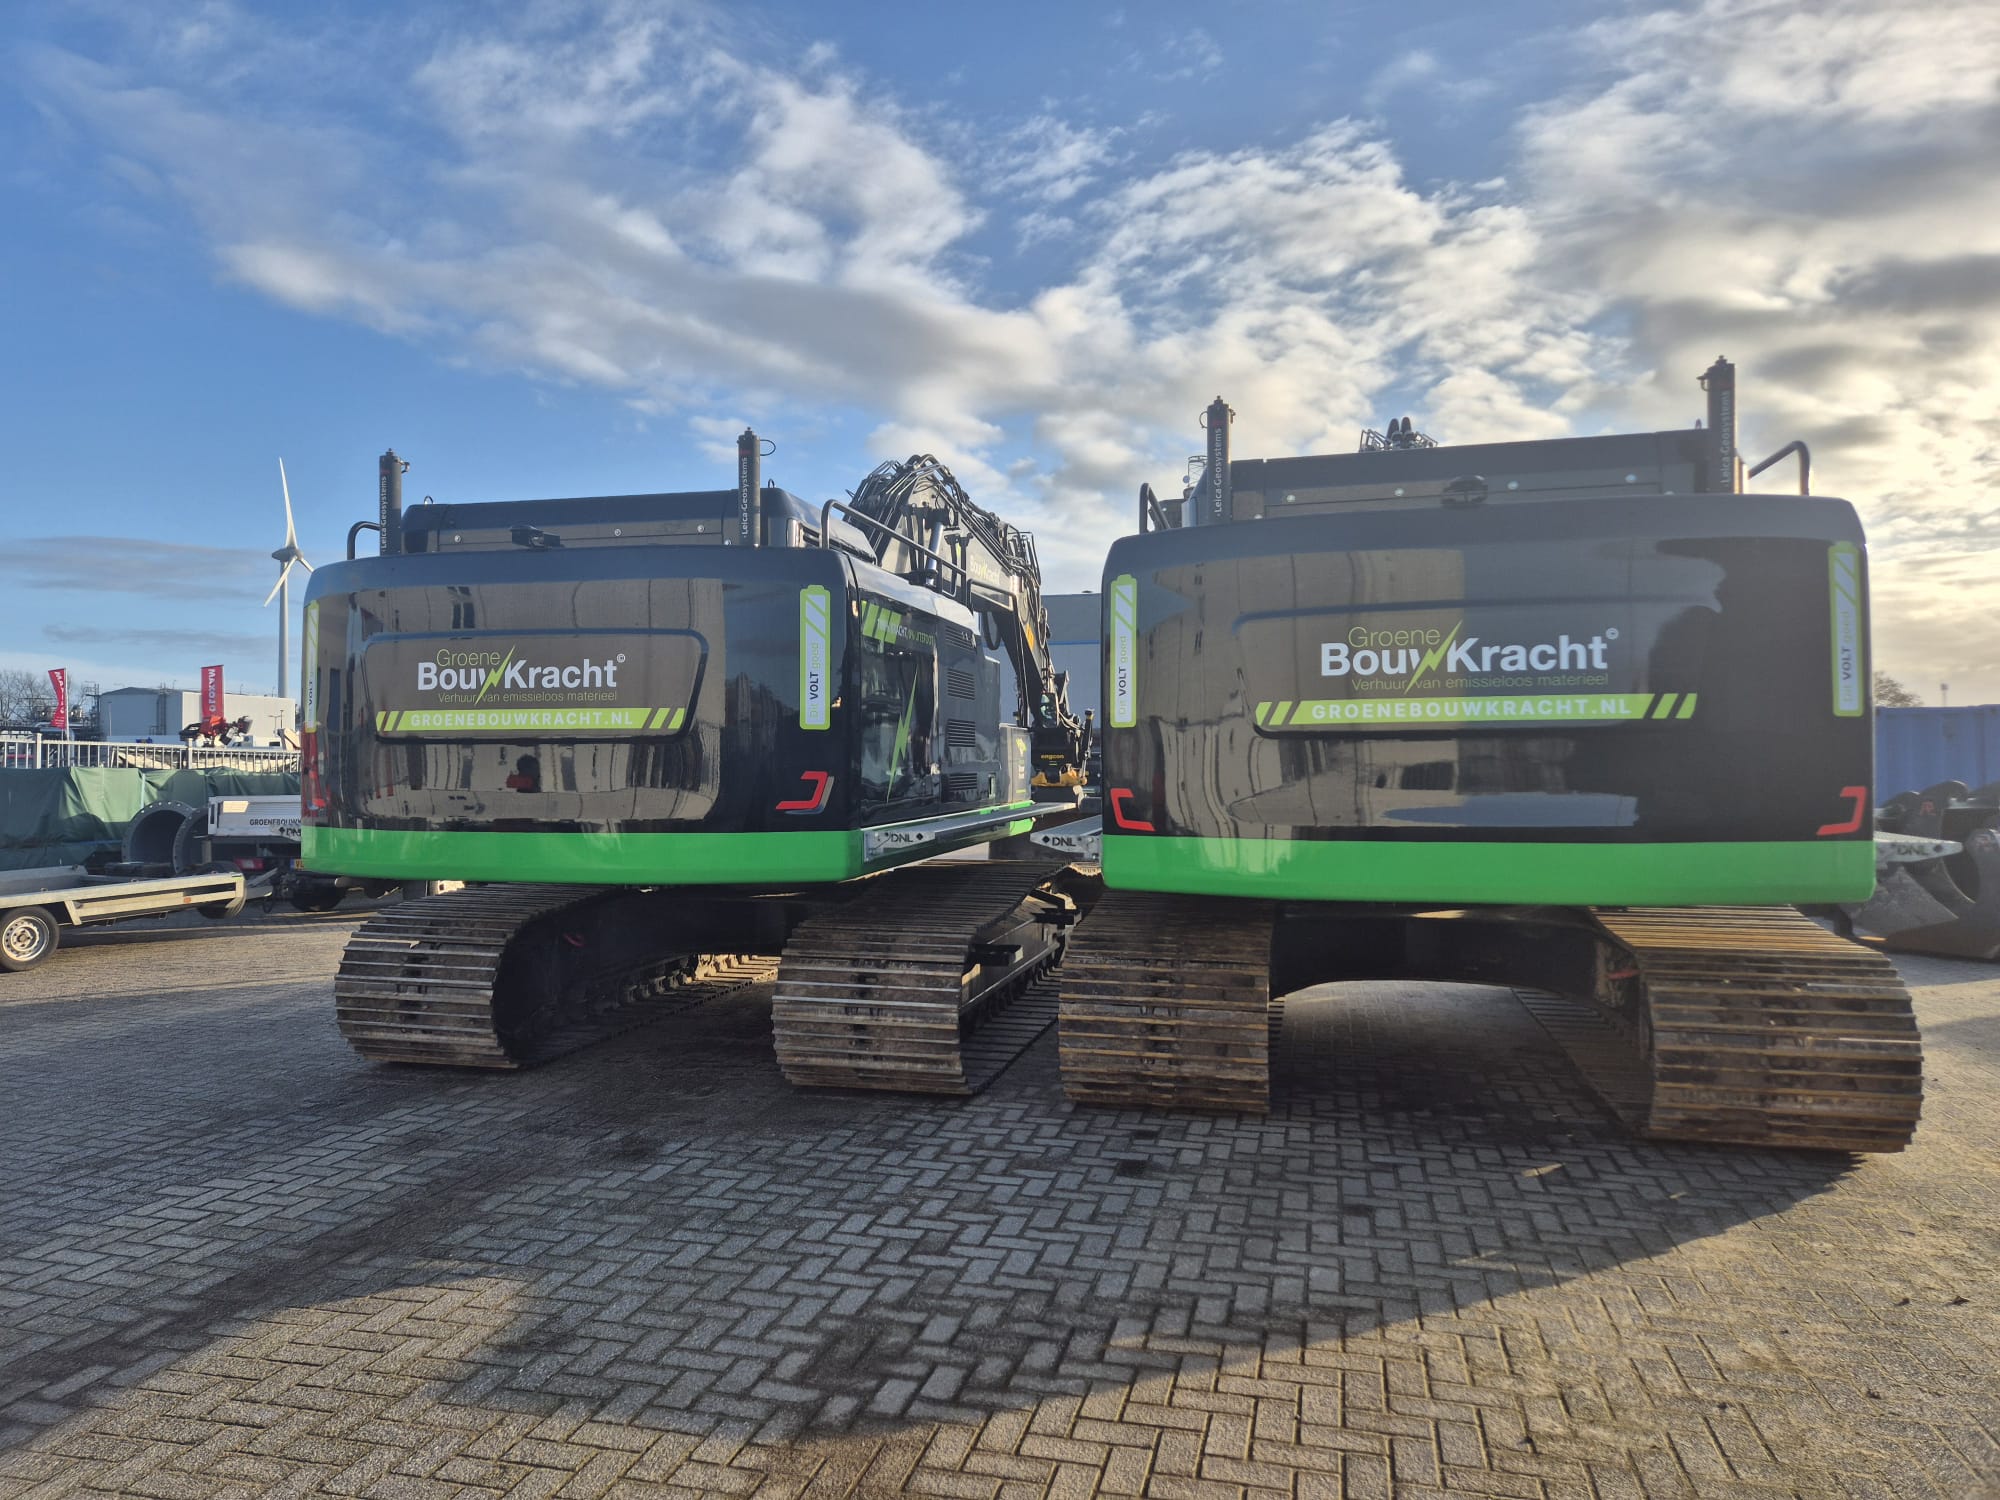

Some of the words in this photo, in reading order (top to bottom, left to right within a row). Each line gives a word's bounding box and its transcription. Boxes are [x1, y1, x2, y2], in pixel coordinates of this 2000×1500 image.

[1214, 427, 1222, 486] Geosystems
[741, 457, 749, 511] Geosystems
[1214, 488, 1222, 513] Leica
[1348, 626, 1441, 647] Groene
[436, 649, 500, 667] Groene
[1842, 646, 1851, 680] VOLT
[810, 672, 818, 700] VOLT
[1118, 666, 1126, 696] VOLT
[1352, 679, 1406, 691] Verhuur
[1415, 680, 1441, 690] van
[1445, 677, 1533, 689] emissieloos
[1538, 674, 1609, 687] materieel
[438, 692, 476, 704] Verhuur
[480, 691, 500, 703] van
[503, 691, 564, 702] emissieloos
[567, 690, 617, 701] materieel
[410, 710, 633, 727] GROENEBOUWKRACHT.NL
[1311, 698, 1633, 720] GROENEBOUWKRACHT.NL
[891, 833, 914, 842] DNL
[1052, 836, 1076, 846] DNL
